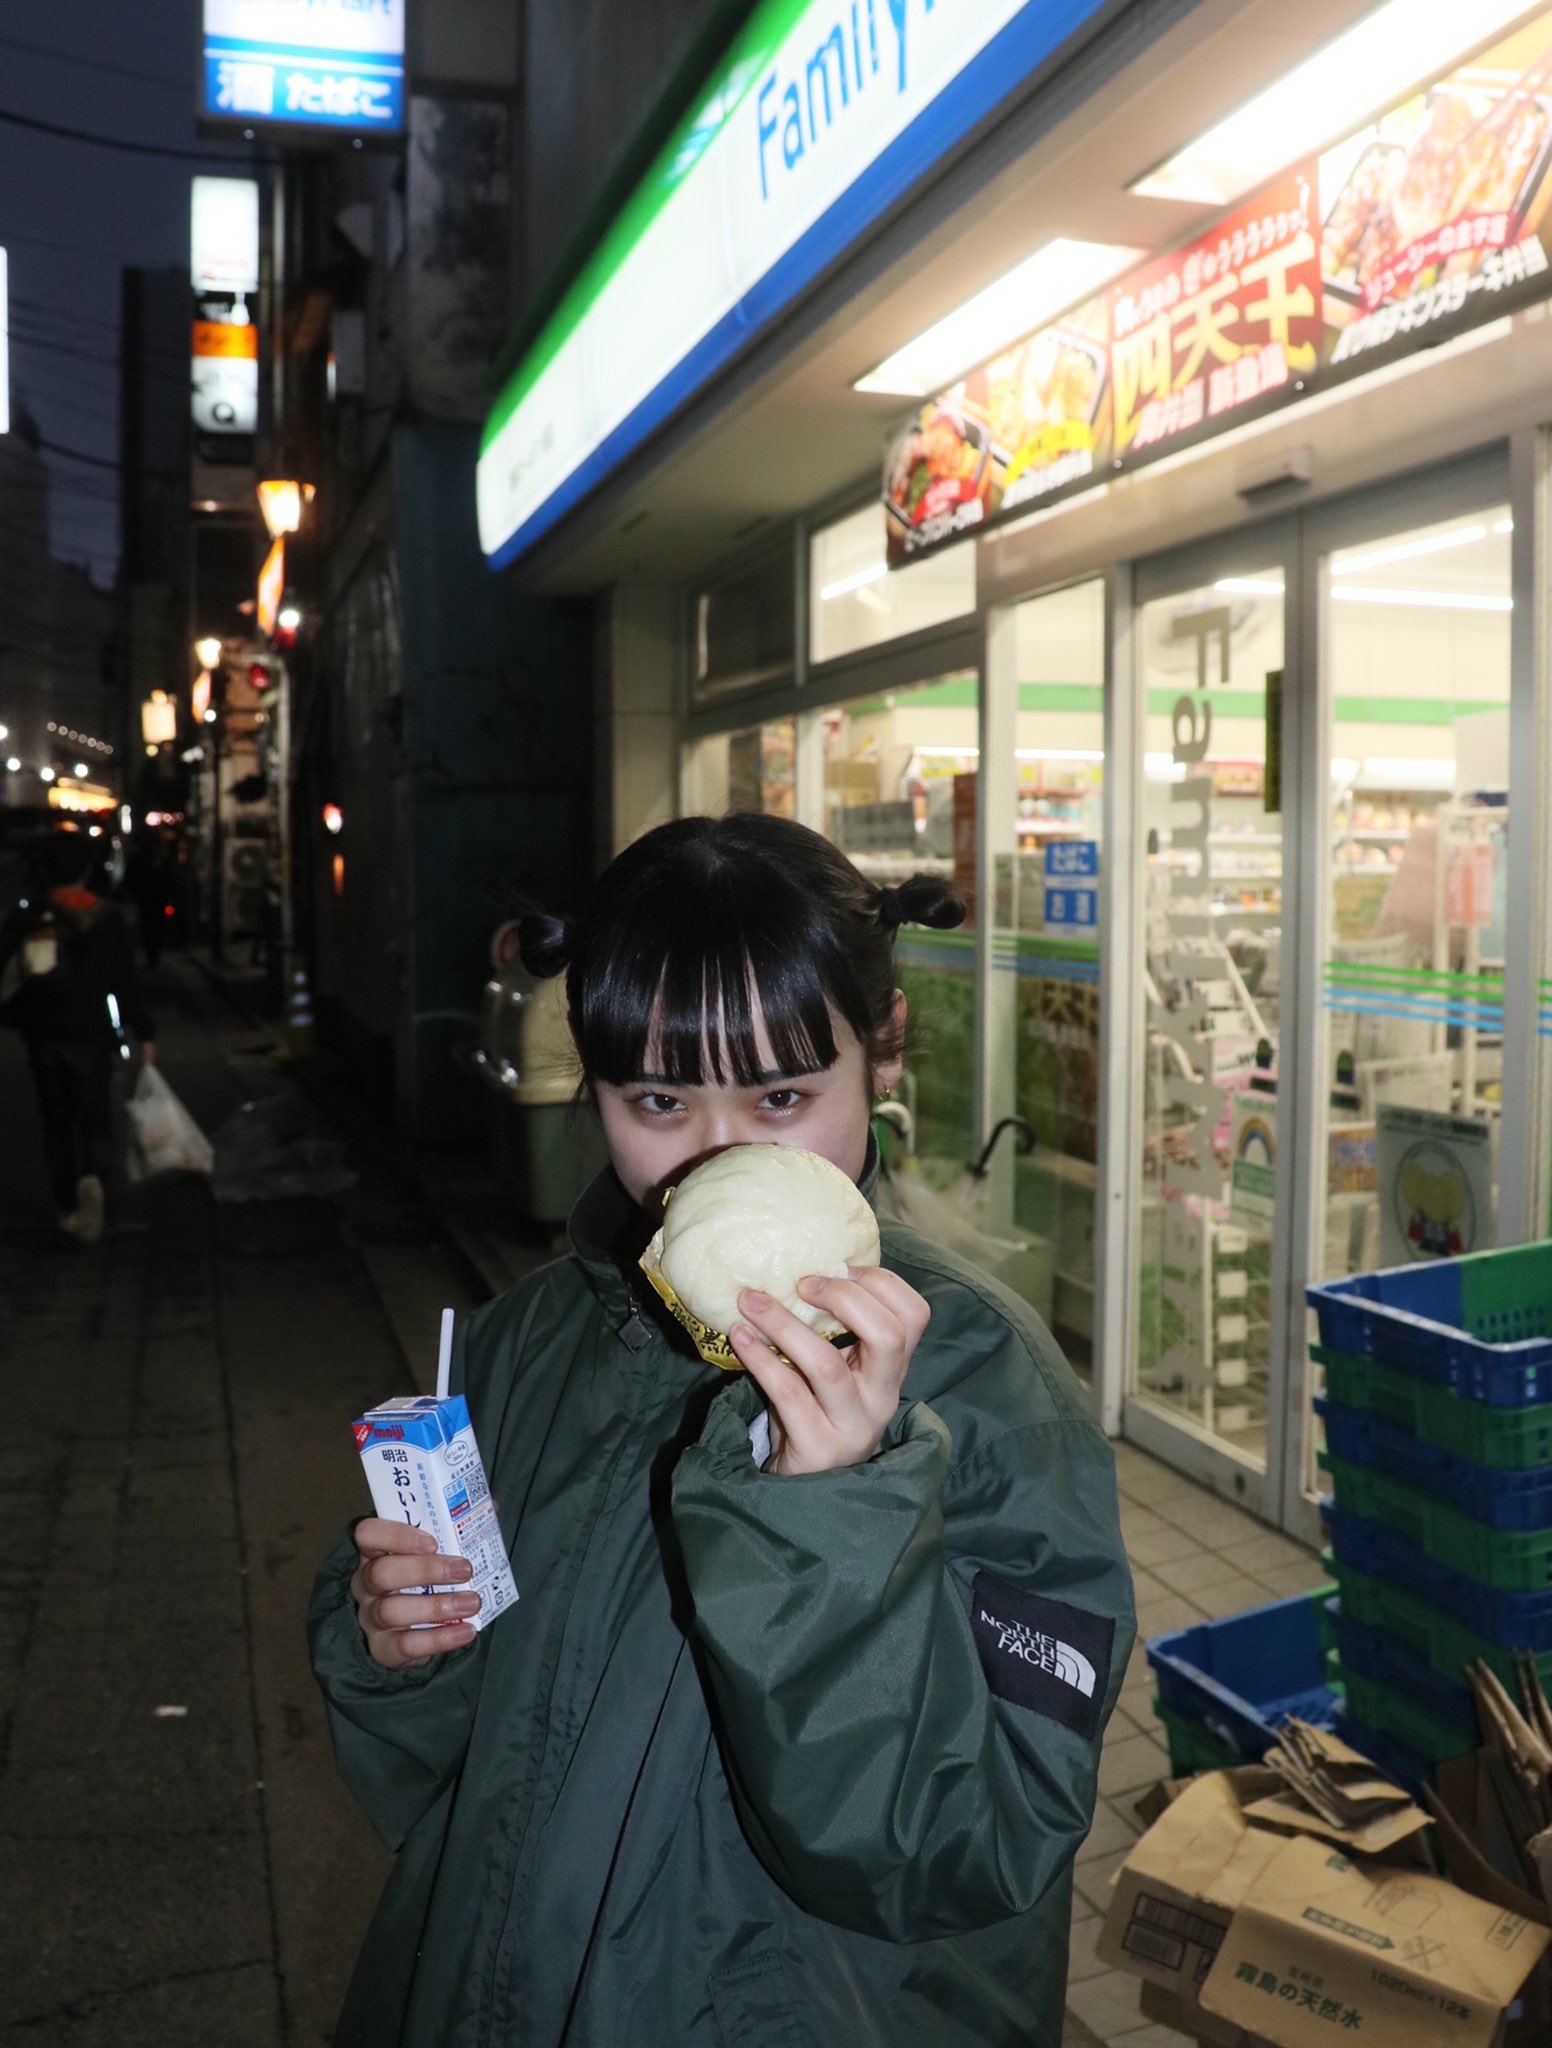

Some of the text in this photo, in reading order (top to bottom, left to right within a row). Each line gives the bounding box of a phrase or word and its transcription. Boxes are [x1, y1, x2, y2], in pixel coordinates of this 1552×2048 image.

[286, 72, 393, 119] たばこ
[758, 0, 934, 201] Family
[1111, 231, 1316, 455] 四天王
[374, 1423, 405, 1441] meiji
[381, 1449, 408, 1463] 明治
[980, 1609, 1055, 1660] NORTH
[997, 1632, 1055, 1674] FACE
[1011, 1619, 1055, 1646] THE
[1233, 1961, 1363, 2030] 霧島の天然水
